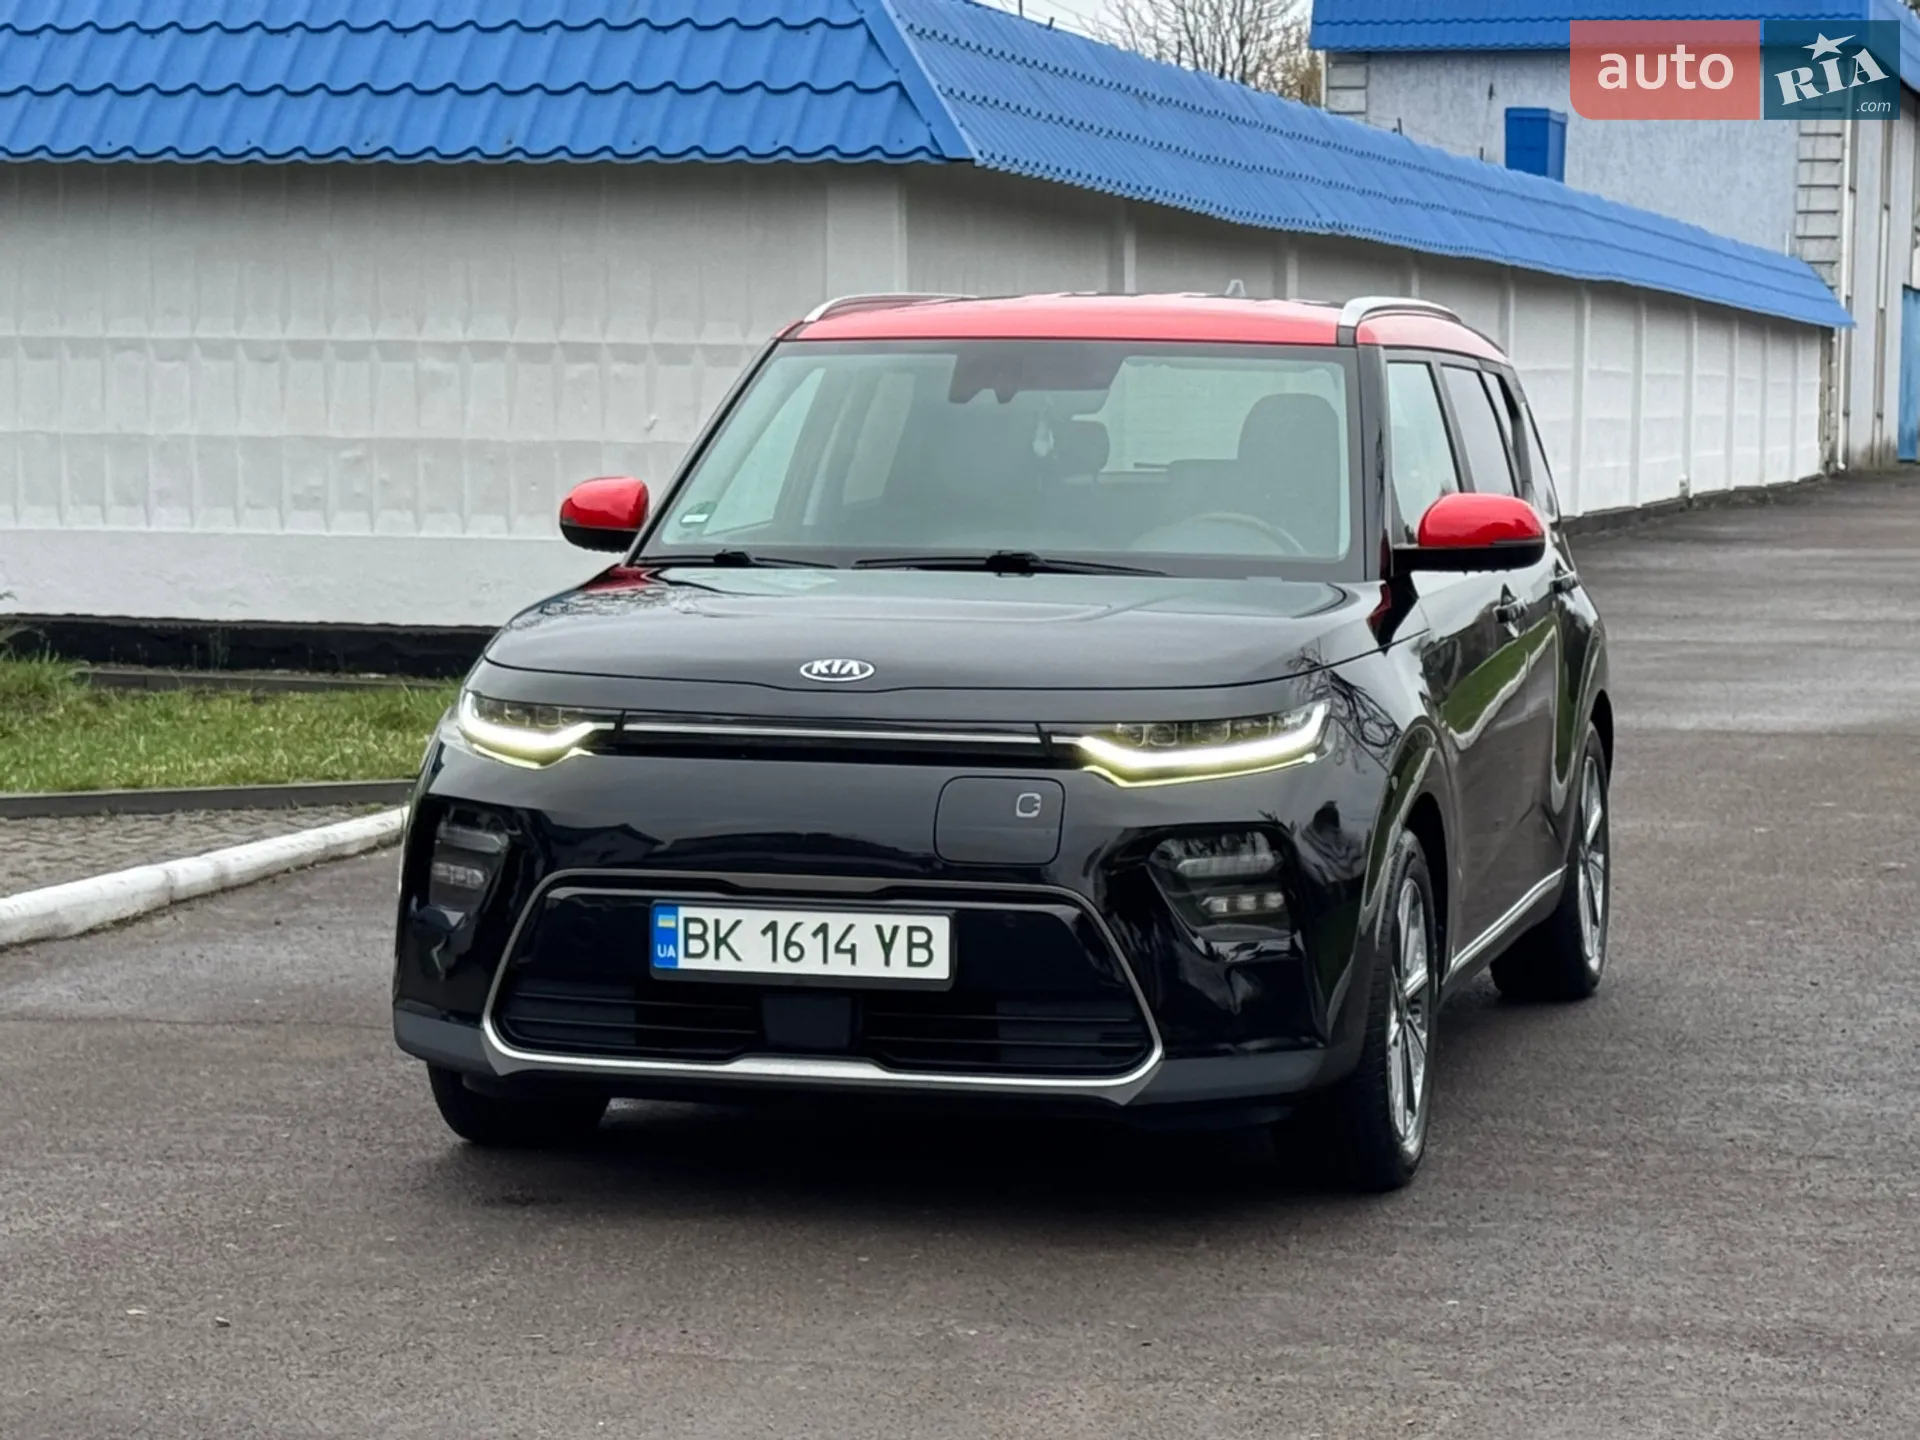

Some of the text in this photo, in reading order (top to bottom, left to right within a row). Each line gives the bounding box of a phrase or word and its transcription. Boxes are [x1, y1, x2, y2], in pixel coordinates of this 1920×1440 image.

[811, 660, 860, 675] KIA
[683, 916, 934, 967] BK 1614 YB
[657, 944, 676, 958] UA
